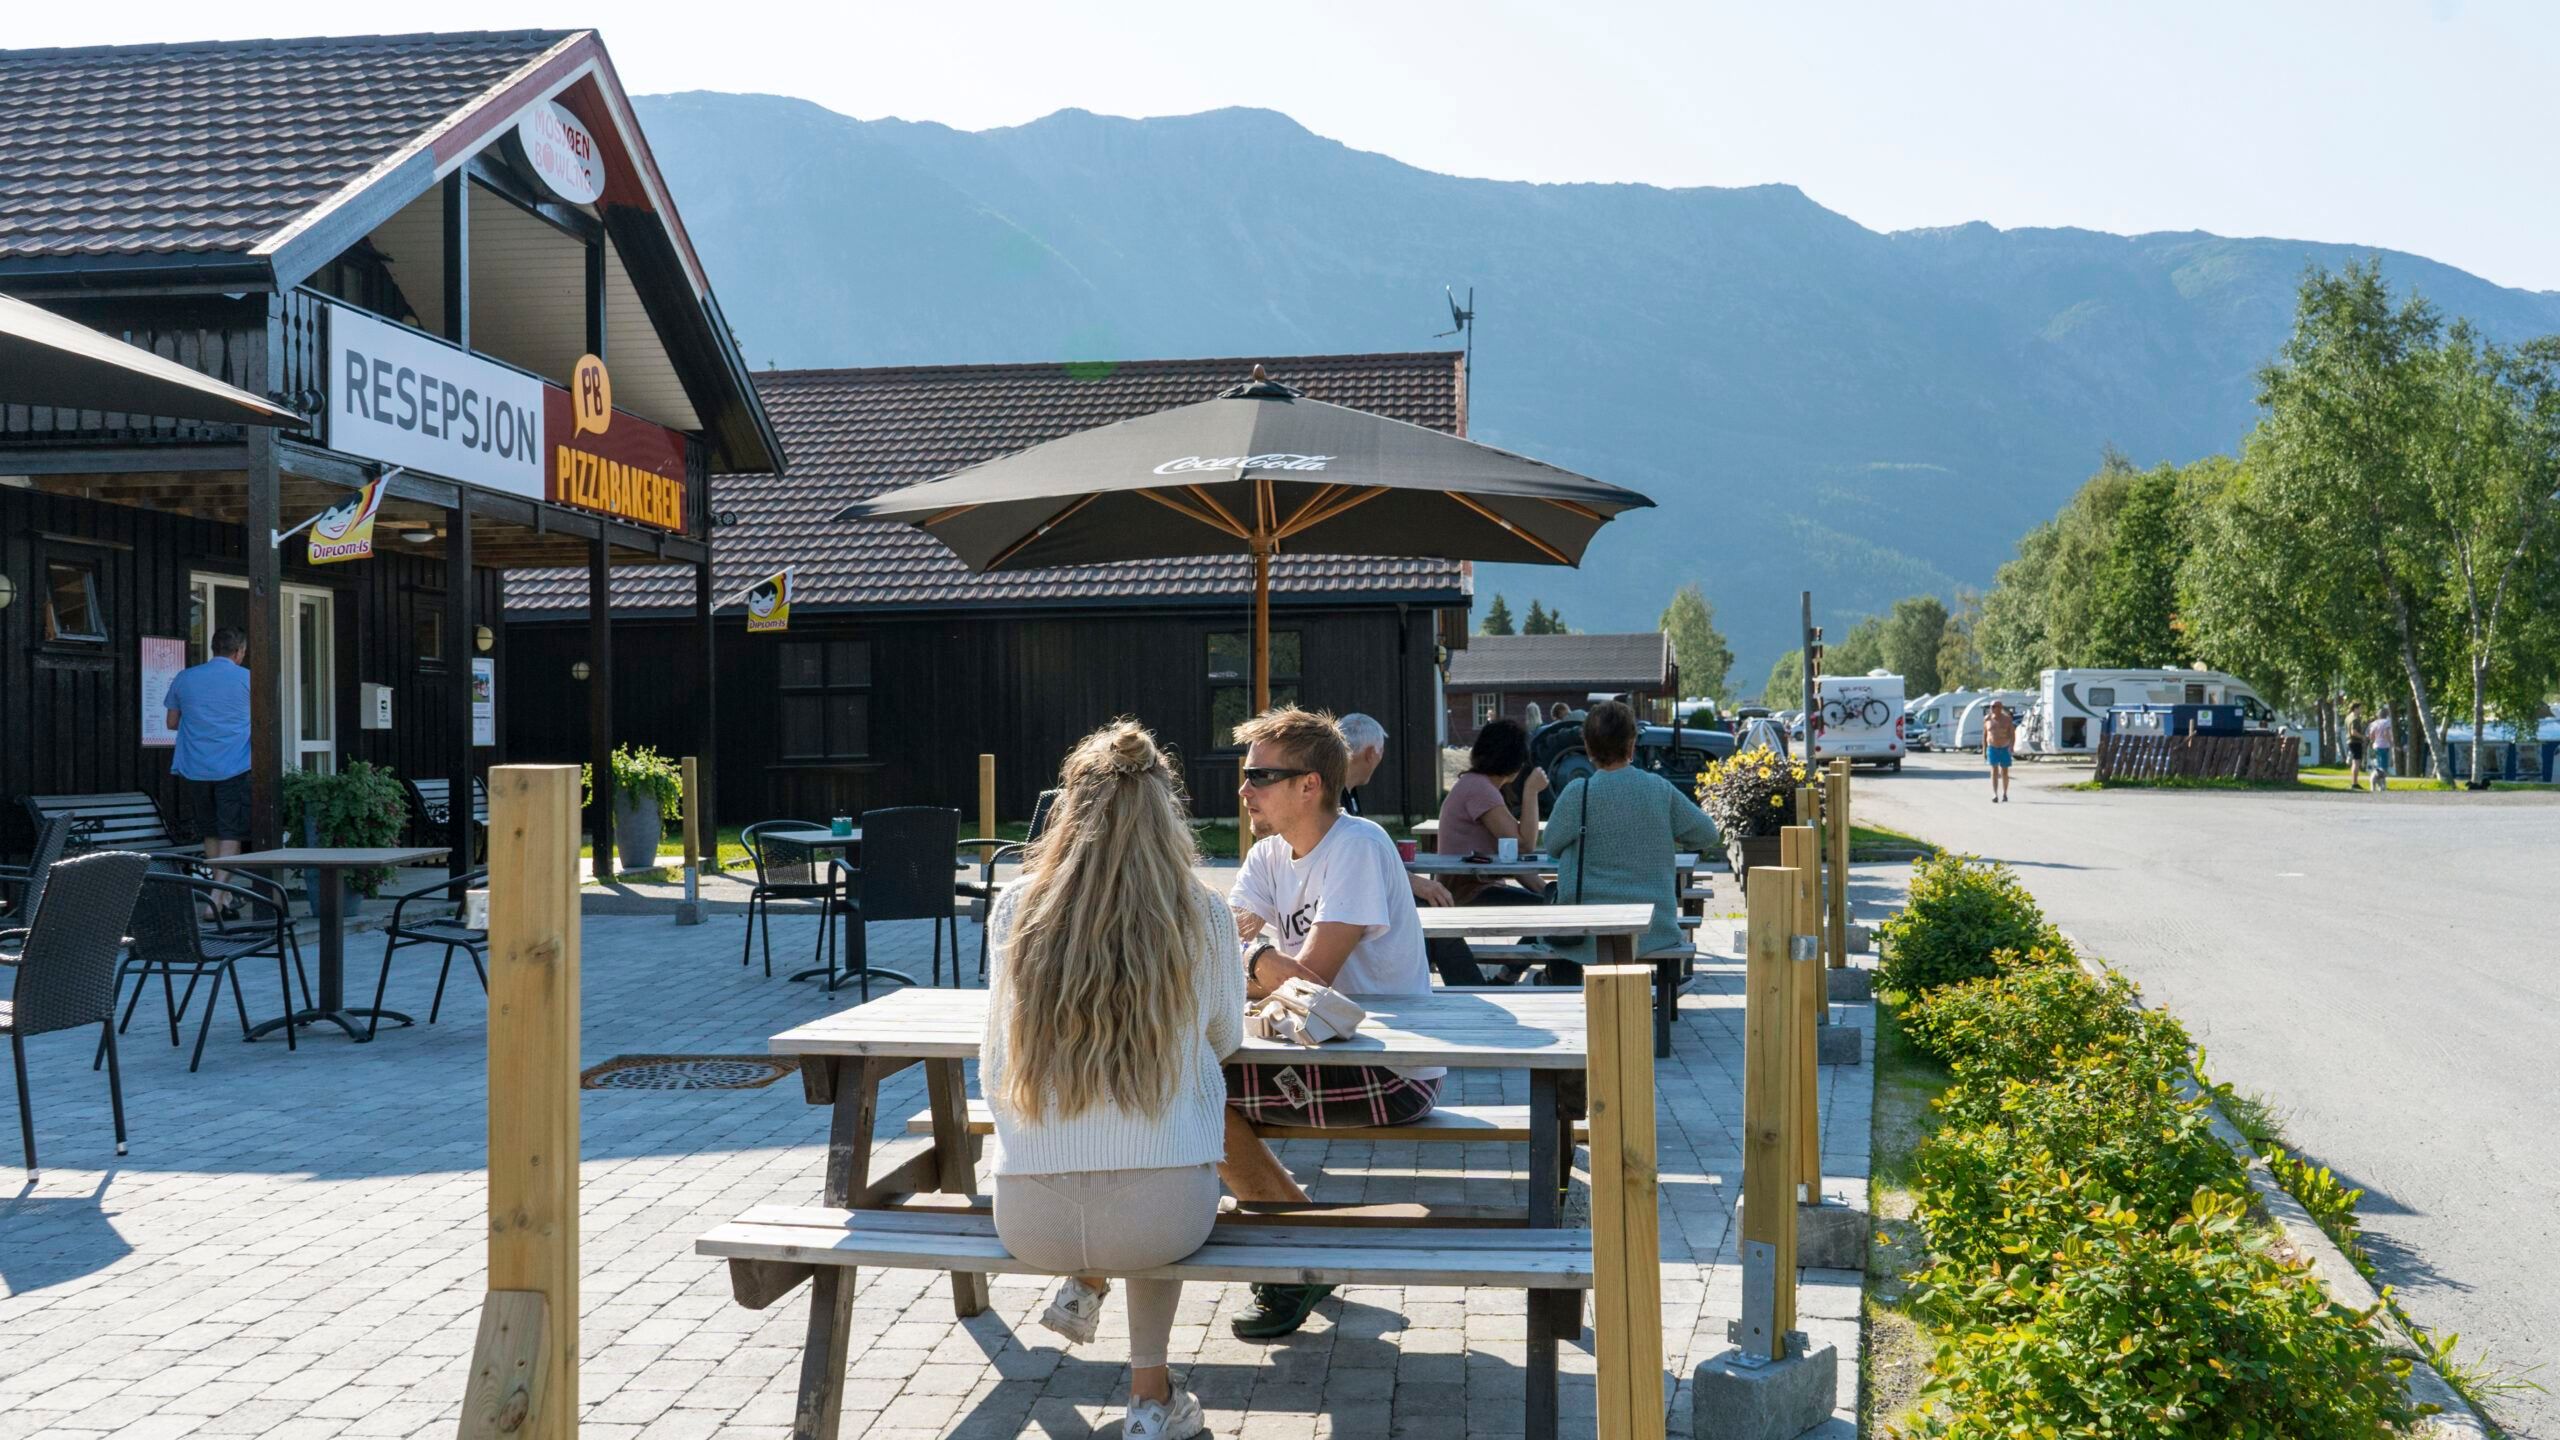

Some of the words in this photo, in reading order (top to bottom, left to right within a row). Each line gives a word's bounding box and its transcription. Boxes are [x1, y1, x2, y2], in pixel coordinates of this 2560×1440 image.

[535, 110, 590, 160] MOSJØEN
[346, 349, 536, 465] RESEPSJON
[582, 366, 603, 418] PB
[557, 444, 681, 529] PIZZABAKEREN
[1153, 454, 1337, 474] Coca-Cola
